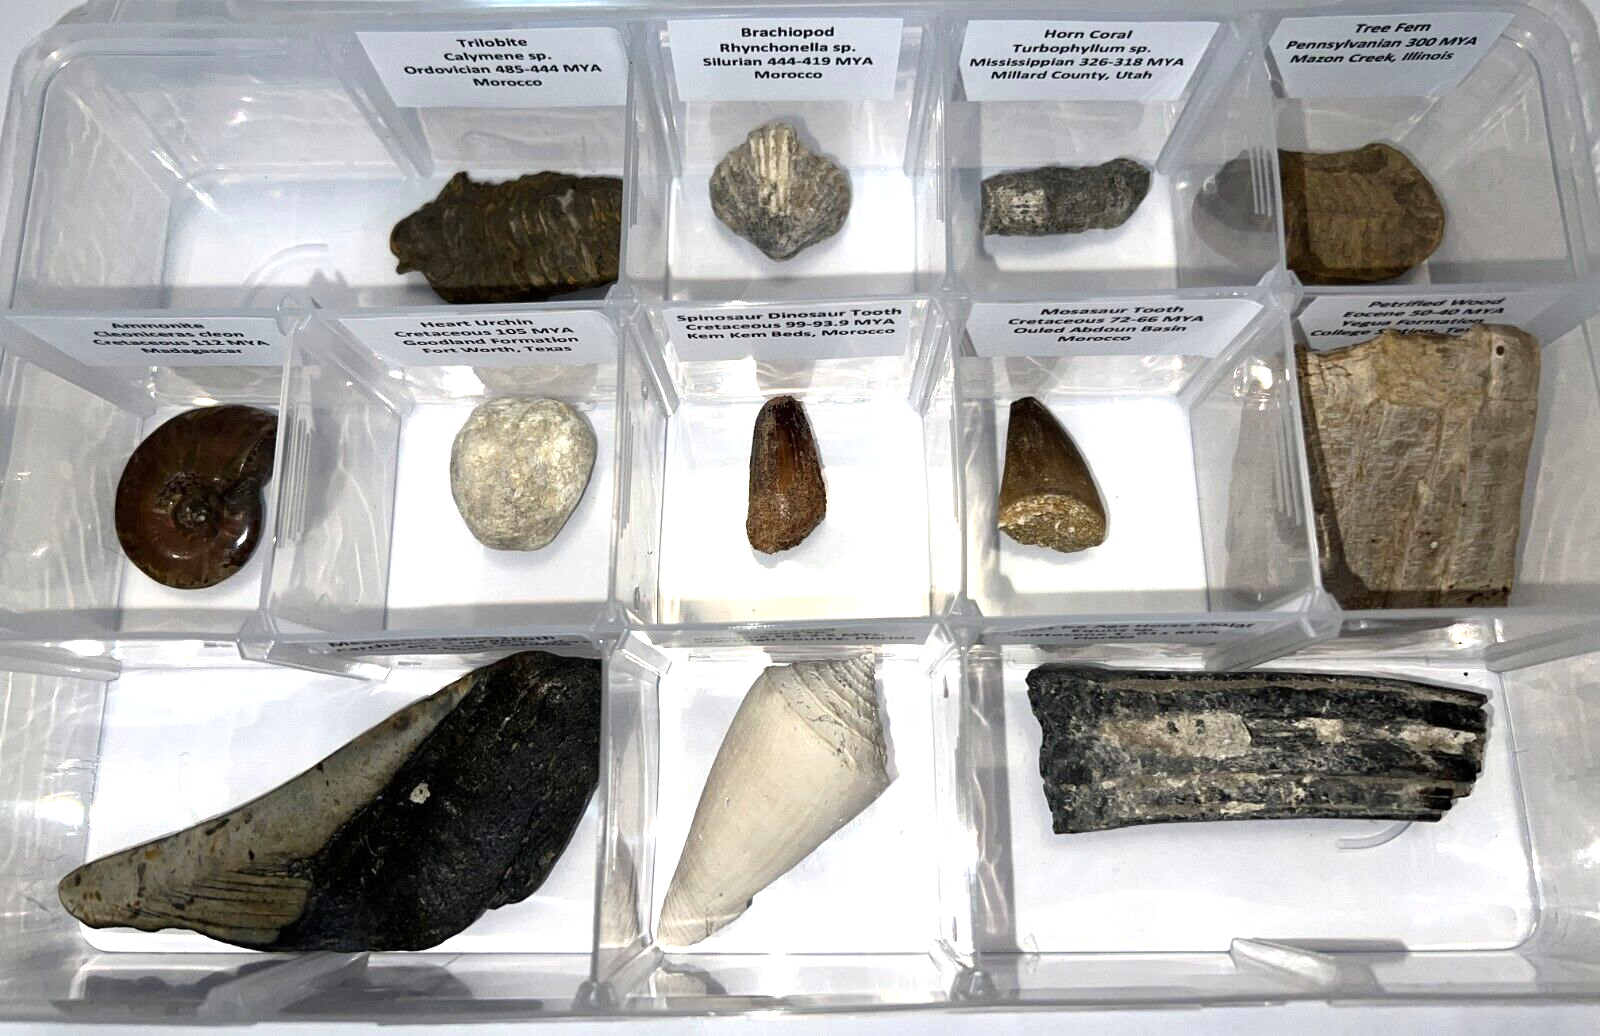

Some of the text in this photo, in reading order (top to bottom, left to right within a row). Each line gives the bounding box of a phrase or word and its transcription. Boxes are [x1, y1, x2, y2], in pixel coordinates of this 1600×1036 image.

[741, 27, 835, 39] Brachiopod
[1354, 23, 1432, 33] Tree Fern
[1044, 29, 1133, 39] Horn Coral
[456, 38, 528, 48] Trilobite
[719, 42, 856, 54] Rhynchonella sp.
[1286, 36, 1478, 51] Pennsylvanian 300 MYA
[1012, 44, 1151, 55] Turbophyllum sp.
[443, 51, 552, 62] Calymene sp.
[1289, 51, 1455, 63] Mazon Creek, Illinois
[702, 57, 873, 67] Silurian 444-419 MYA
[969, 58, 1184, 68] Mississippian 326-318 MYA
[403, 64, 602, 75] Ordovician 485-444 MYA
[754, 70, 823, 79] Morocco
[991, 71, 1152, 81] Millard County, Utah
[473, 77, 542, 87] Morocco
[1367, 298, 1506, 308] Petrified Wood
[677, 308, 901, 323] Spinosaur Dinosaur Tooth
[1040, 306, 1184, 315] Mosasaur Tooth
[1343, 307, 1504, 318] Eocene 50-40 MYA
[420, 320, 471, 328] Heart
[685, 318, 895, 331] Cretaceous 99-93.9 MYA
[1008, 317, 1104, 325] Cretaceous
[1109, 316, 1158, 324] 72-66
[1397, 318, 1484, 326] Formation
[394, 329, 492, 337] Cretaceous
[531, 327, 574, 335] MYA
[771, 330, 816, 338] Beds,
[821, 328, 895, 336] Morocco
[1013, 326, 1066, 334] Ouled
[1310, 329, 1371, 337] College
[403, 336, 579, 346] Goodland Formation
